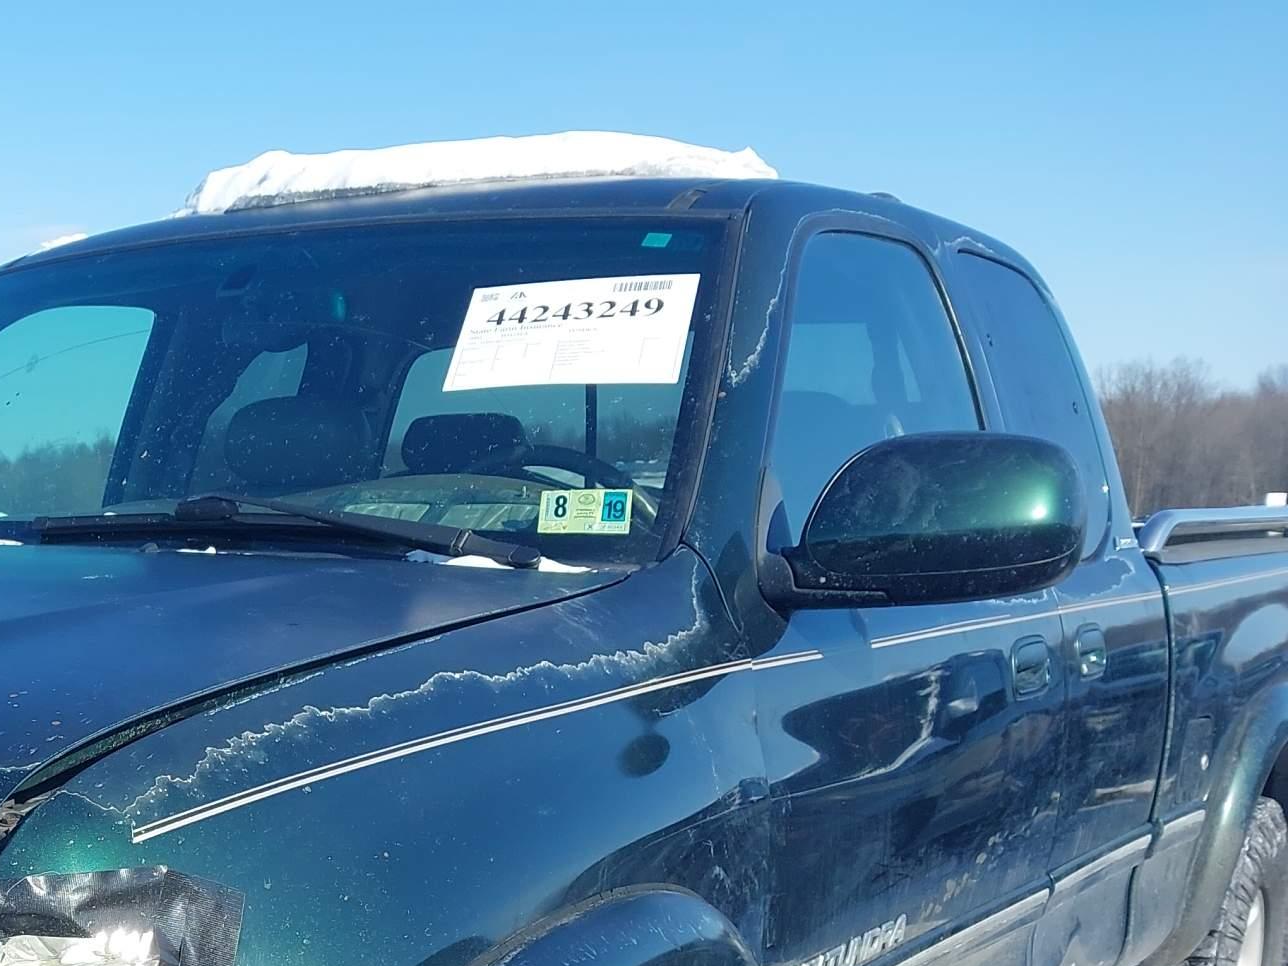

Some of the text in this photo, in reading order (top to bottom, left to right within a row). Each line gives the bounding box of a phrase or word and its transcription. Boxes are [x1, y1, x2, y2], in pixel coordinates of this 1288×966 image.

[486, 297, 665, 326] 44243249
[554, 495, 568, 518] 8
[605, 500, 626, 519] 19
